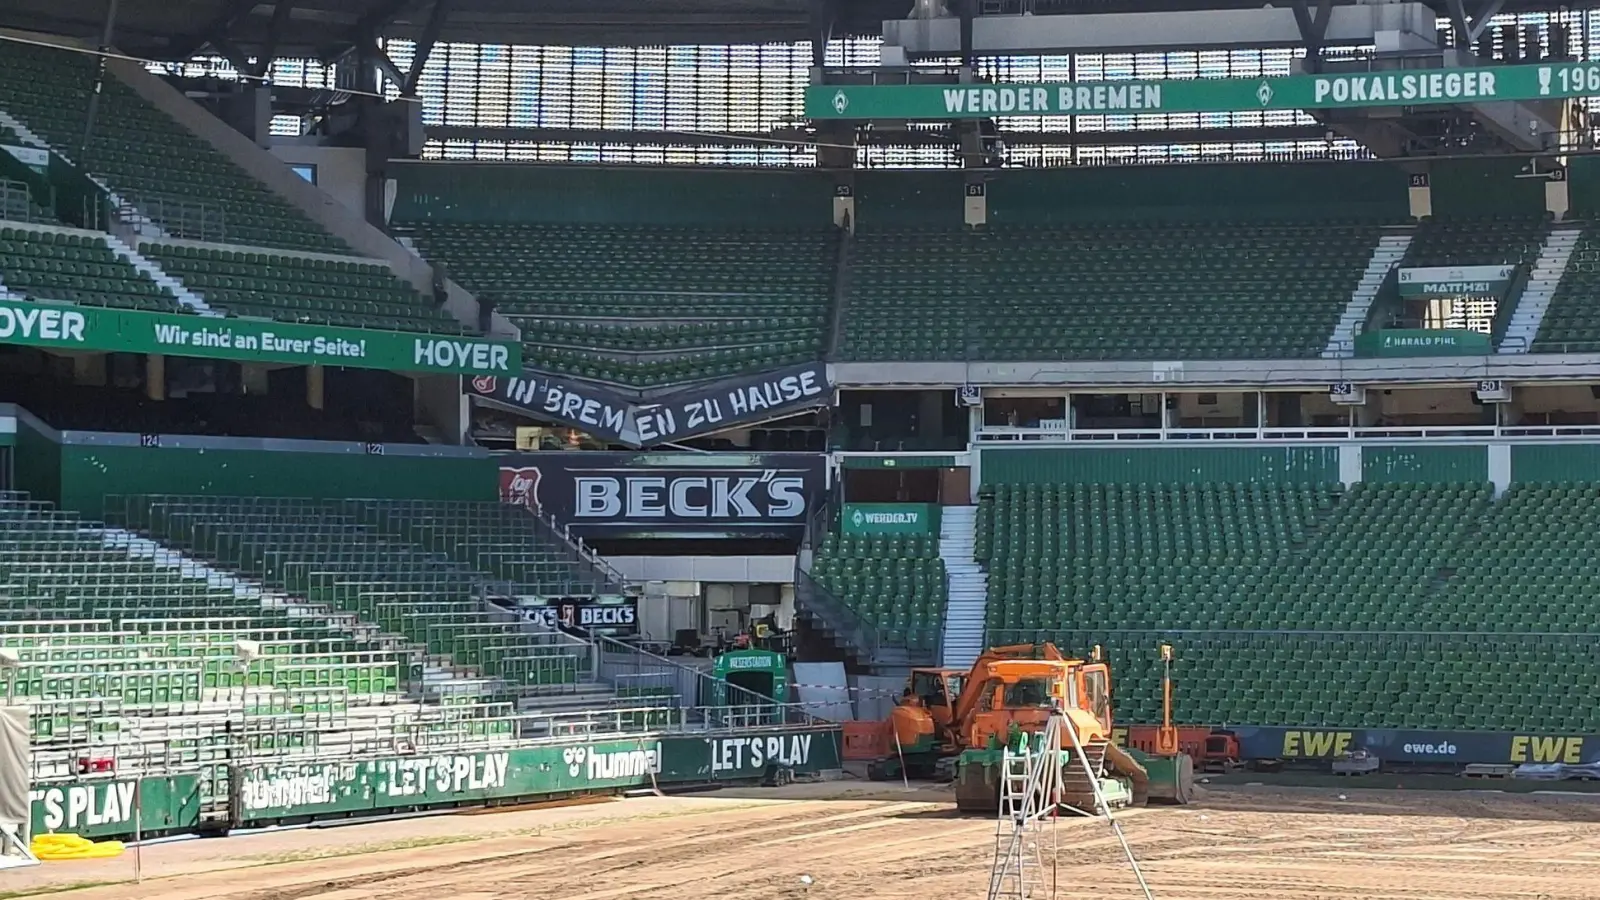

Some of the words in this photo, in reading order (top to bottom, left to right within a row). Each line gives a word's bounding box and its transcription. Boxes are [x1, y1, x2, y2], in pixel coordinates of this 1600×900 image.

[1314, 71, 1496, 103] POKALSIEGER
[1557, 66, 1600, 92] 196
[943, 88, 1049, 113] WERDER
[1058, 84, 1161, 110] BREMEN
[0, 307, 85, 342] OYER
[155, 323, 188, 344] Wir
[192, 327, 232, 348] sind
[234, 335, 258, 350] an
[261, 331, 311, 354] Eurer
[312, 337, 366, 358] Seite!
[1394, 337, 1432, 346] HARALD
[414, 338, 509, 371] HOYER
[506, 376, 537, 404] IN
[684, 398, 723, 429] ZU
[728, 370, 822, 416] HAUSE
[573, 469, 806, 517] BECK'S
[587, 741, 662, 780] hummel
[712, 736, 763, 771] LET'S
[767, 733, 812, 766] PLAY
[1282, 731, 1352, 757] EWE
[1403, 740, 1457, 754] ewe.de
[1510, 735, 1584, 764] EWE
[454, 752, 509, 791] PLAY
[67, 781, 136, 829] PLAY
